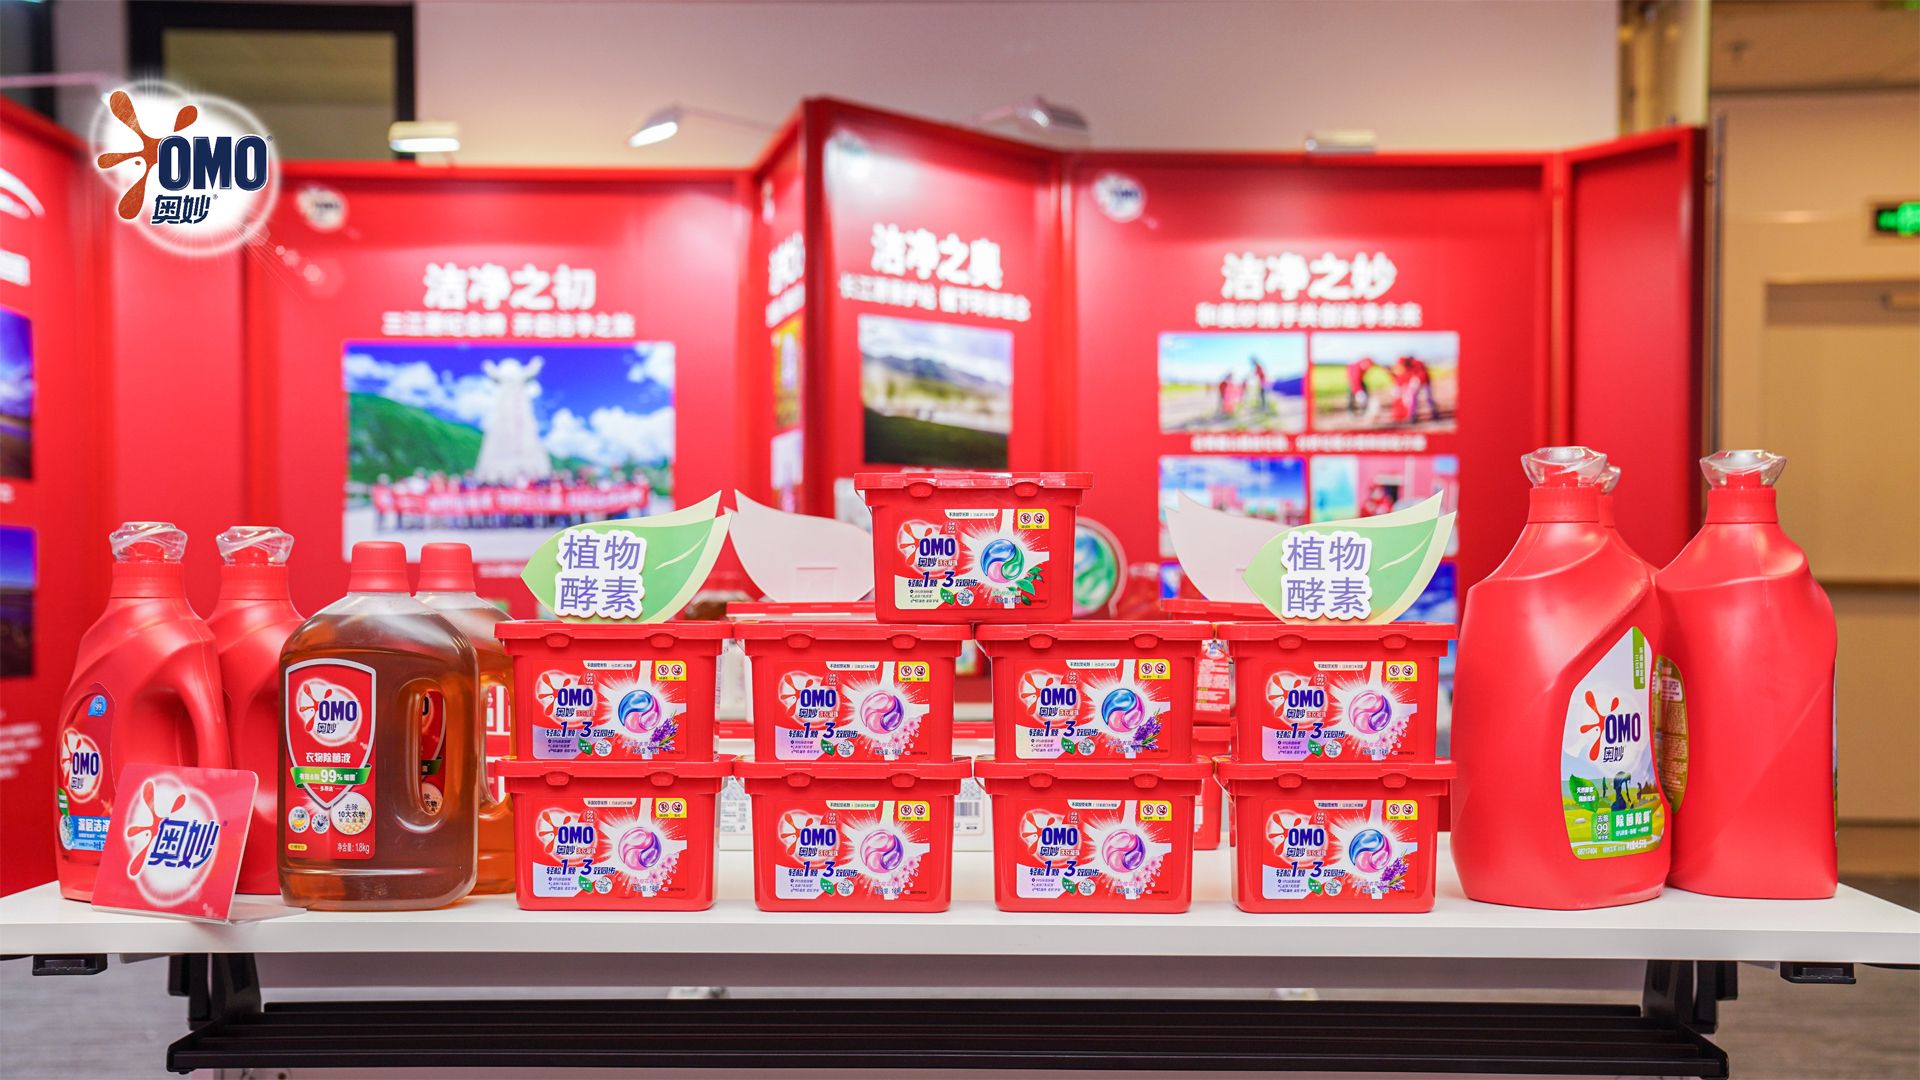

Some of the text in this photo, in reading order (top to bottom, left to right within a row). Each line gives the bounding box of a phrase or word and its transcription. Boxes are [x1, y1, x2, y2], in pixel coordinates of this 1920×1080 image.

[870, 223, 1003, 289] 洁净之奥
[1221, 251, 1398, 301] 洁净之妙
[423, 262, 596, 310] 洁净之初
[562, 534, 640, 571] 植物
[919, 538, 956, 556] OMO
[1286, 536, 1366, 572] 植物
[918, 558, 936, 567] 奥妙
[560, 575, 638, 612] 酵素
[1286, 576, 1366, 614] 酵素
[558, 688, 593, 706] OMO
[800, 689, 836, 707] OMO
[1041, 688, 1076, 706] OMO
[1288, 690, 1324, 707] OMO
[319, 700, 358, 721] OMO
[556, 708, 575, 717] 奥妙
[799, 708, 818, 718] 奥妙
[1039, 708, 1058, 717] 奥妙
[1287, 709, 1305, 718] 奥妙
[317, 722, 336, 734] 奥妙
[1605, 712, 1640, 744] OMO
[306, 752, 350, 763] 衣物除菌液
[1603, 746, 1625, 762] 奥妙
[72, 752, 99, 776] OMO
[558, 826, 593, 844] OMO
[800, 828, 836, 846] OMO
[1042, 827, 1078, 845] OMO
[1288, 828, 1324, 846] OMO
[1596, 824, 1608, 834] 99
[148, 817, 220, 869] 奥妙
[556, 845, 575, 855] 奥妙
[799, 847, 817, 857] 奥妙
[1040, 847, 1058, 856] 奥妙
[1286, 848, 1305, 857] 奥妙
